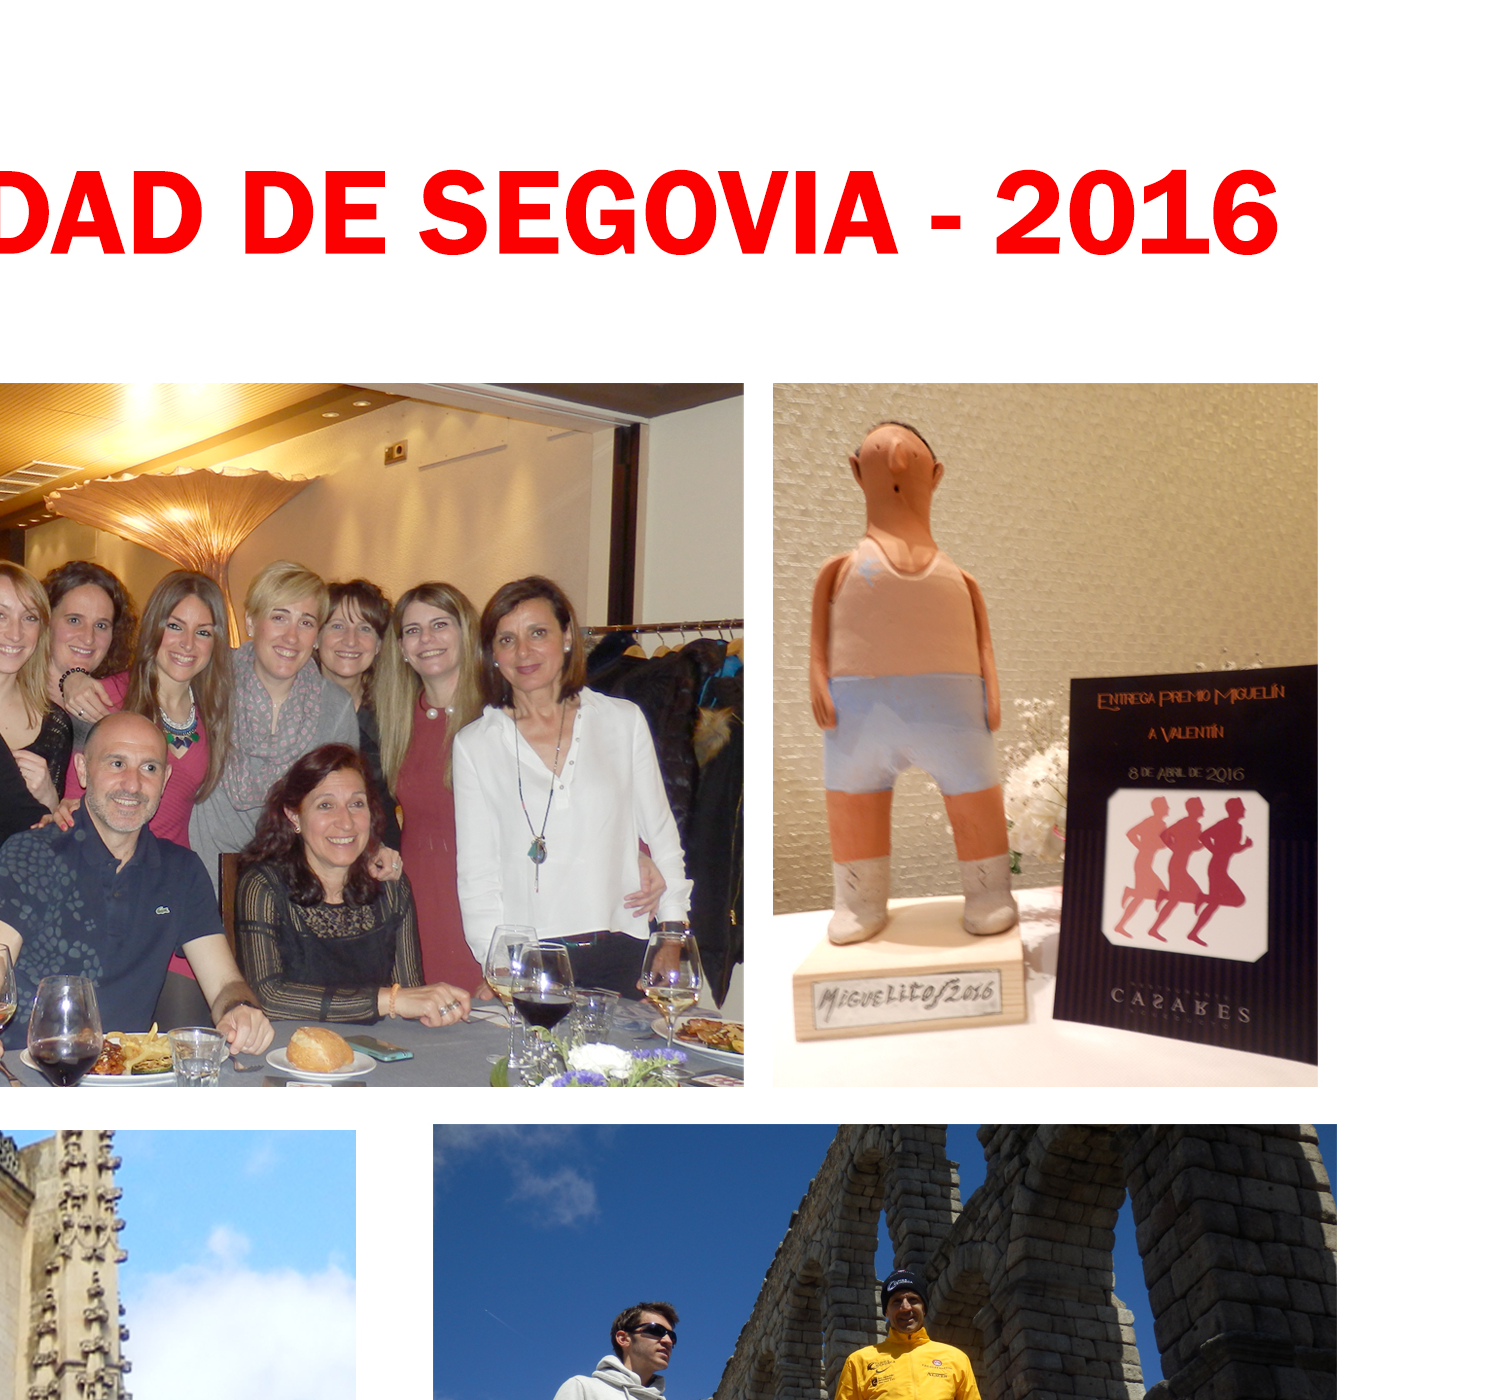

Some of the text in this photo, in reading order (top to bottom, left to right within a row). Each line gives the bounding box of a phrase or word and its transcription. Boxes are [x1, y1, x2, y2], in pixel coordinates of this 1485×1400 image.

[1128, 767, 1139, 780] 8
[1205, 766, 1245, 784] 2016
[1110, 987, 1251, 1023] CASARES
